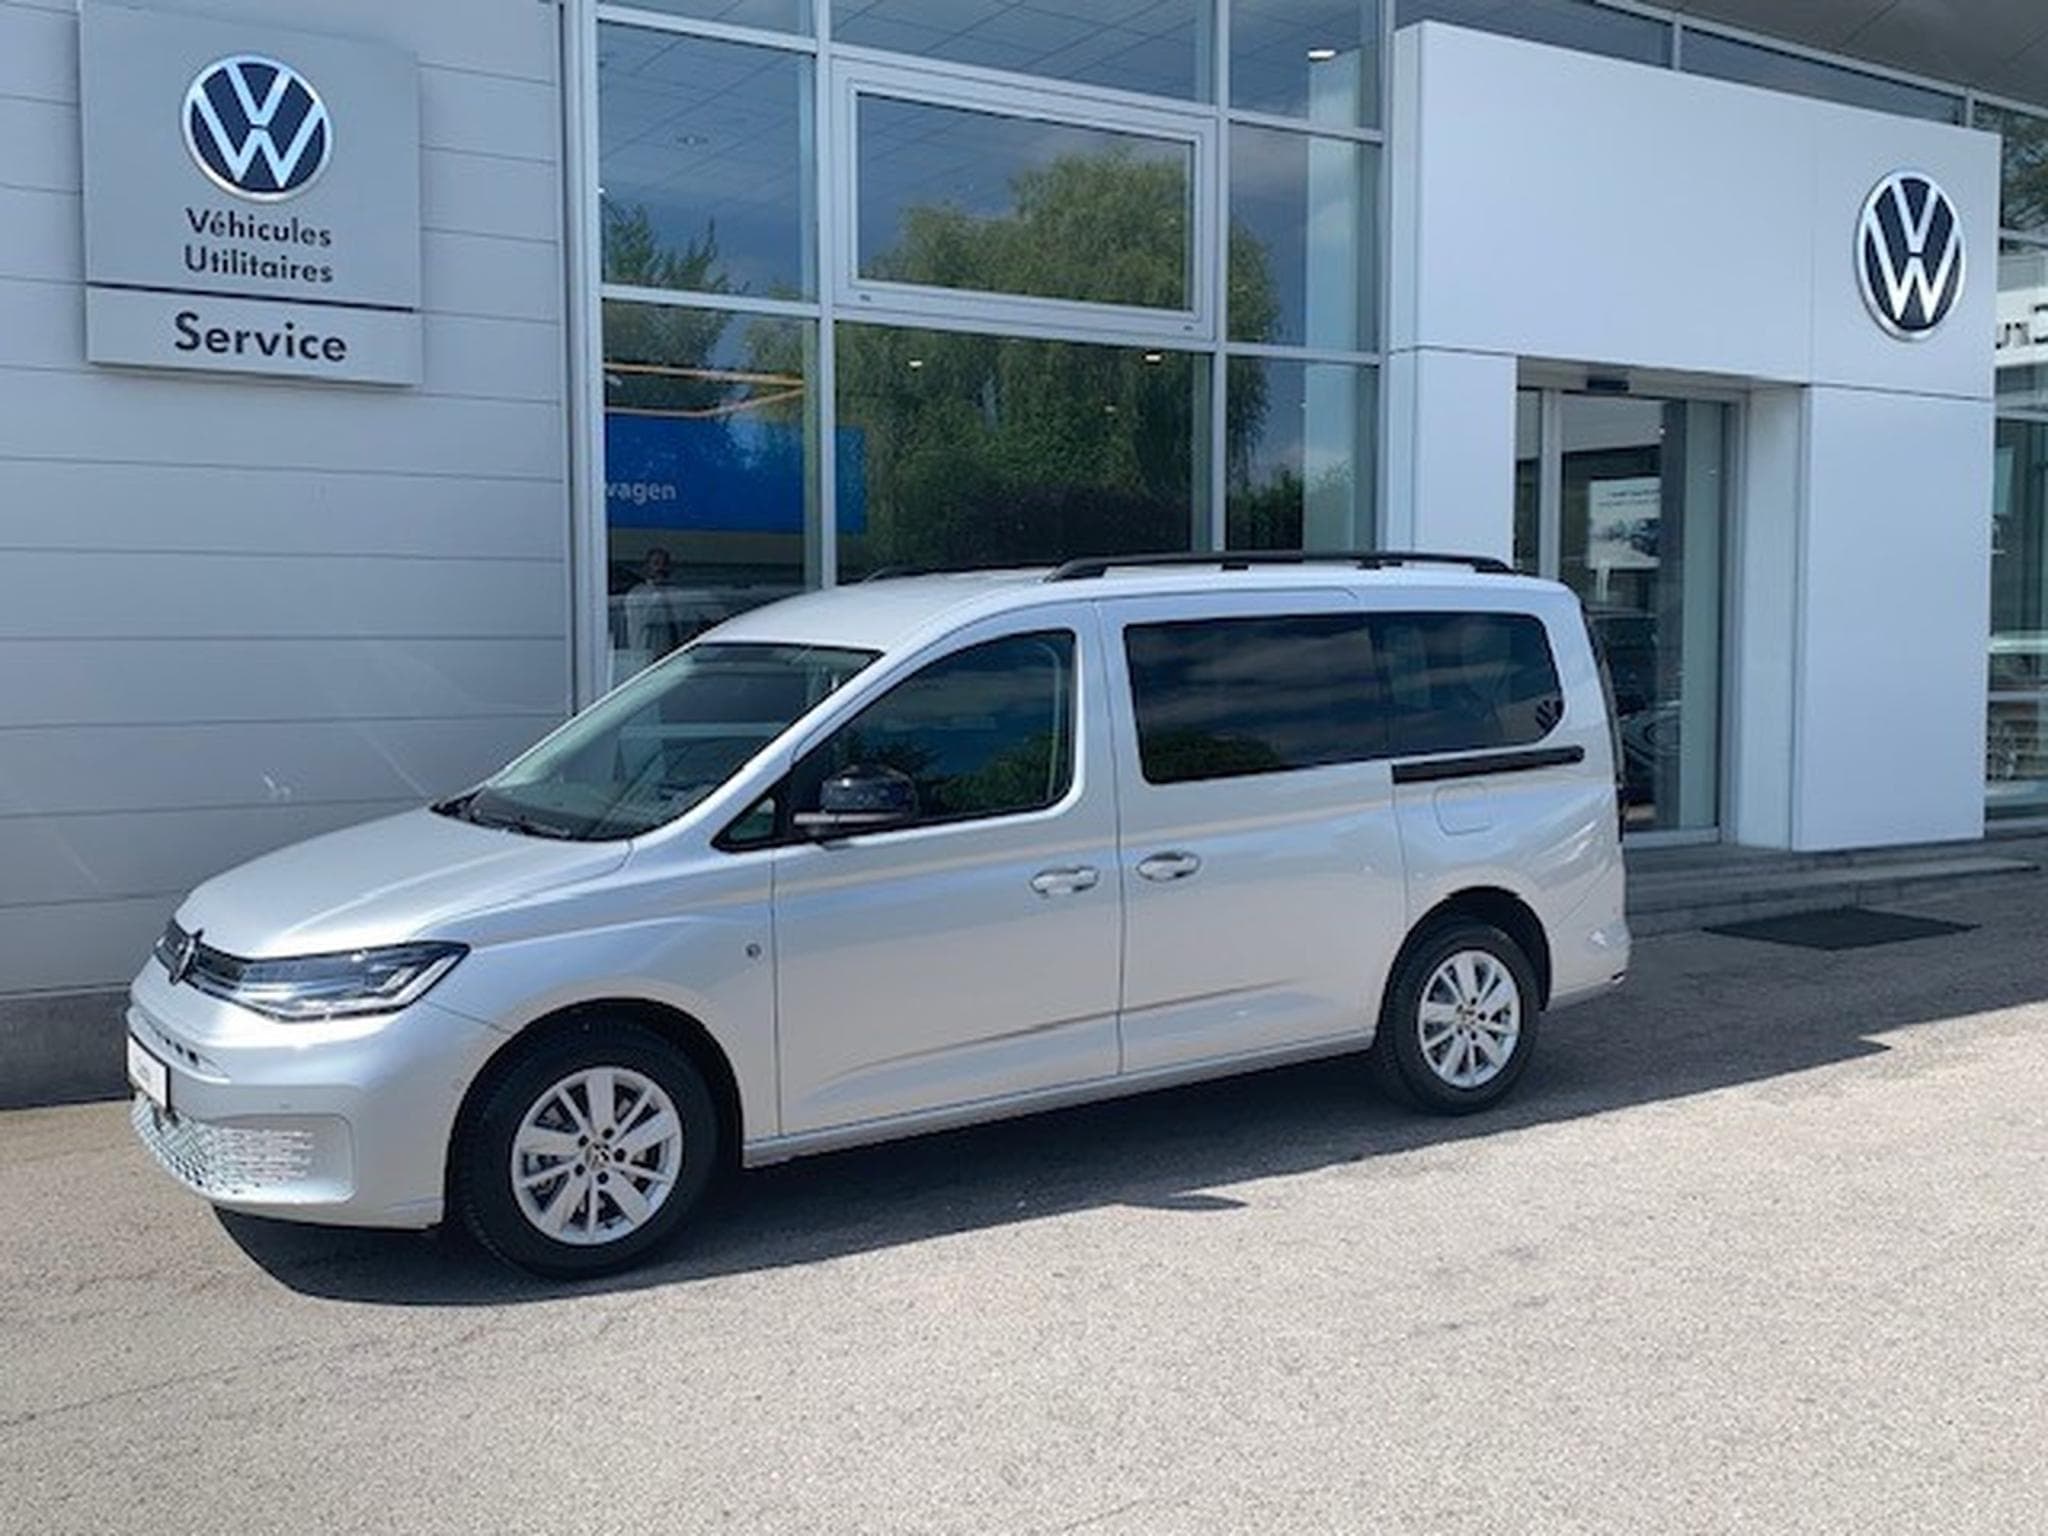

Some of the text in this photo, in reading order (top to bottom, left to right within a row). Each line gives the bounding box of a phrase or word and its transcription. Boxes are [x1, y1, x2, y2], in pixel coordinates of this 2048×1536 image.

[186, 207, 333, 247] Véhicules
[184, 244, 334, 283] Utilitaires
[174, 310, 347, 363] Service
